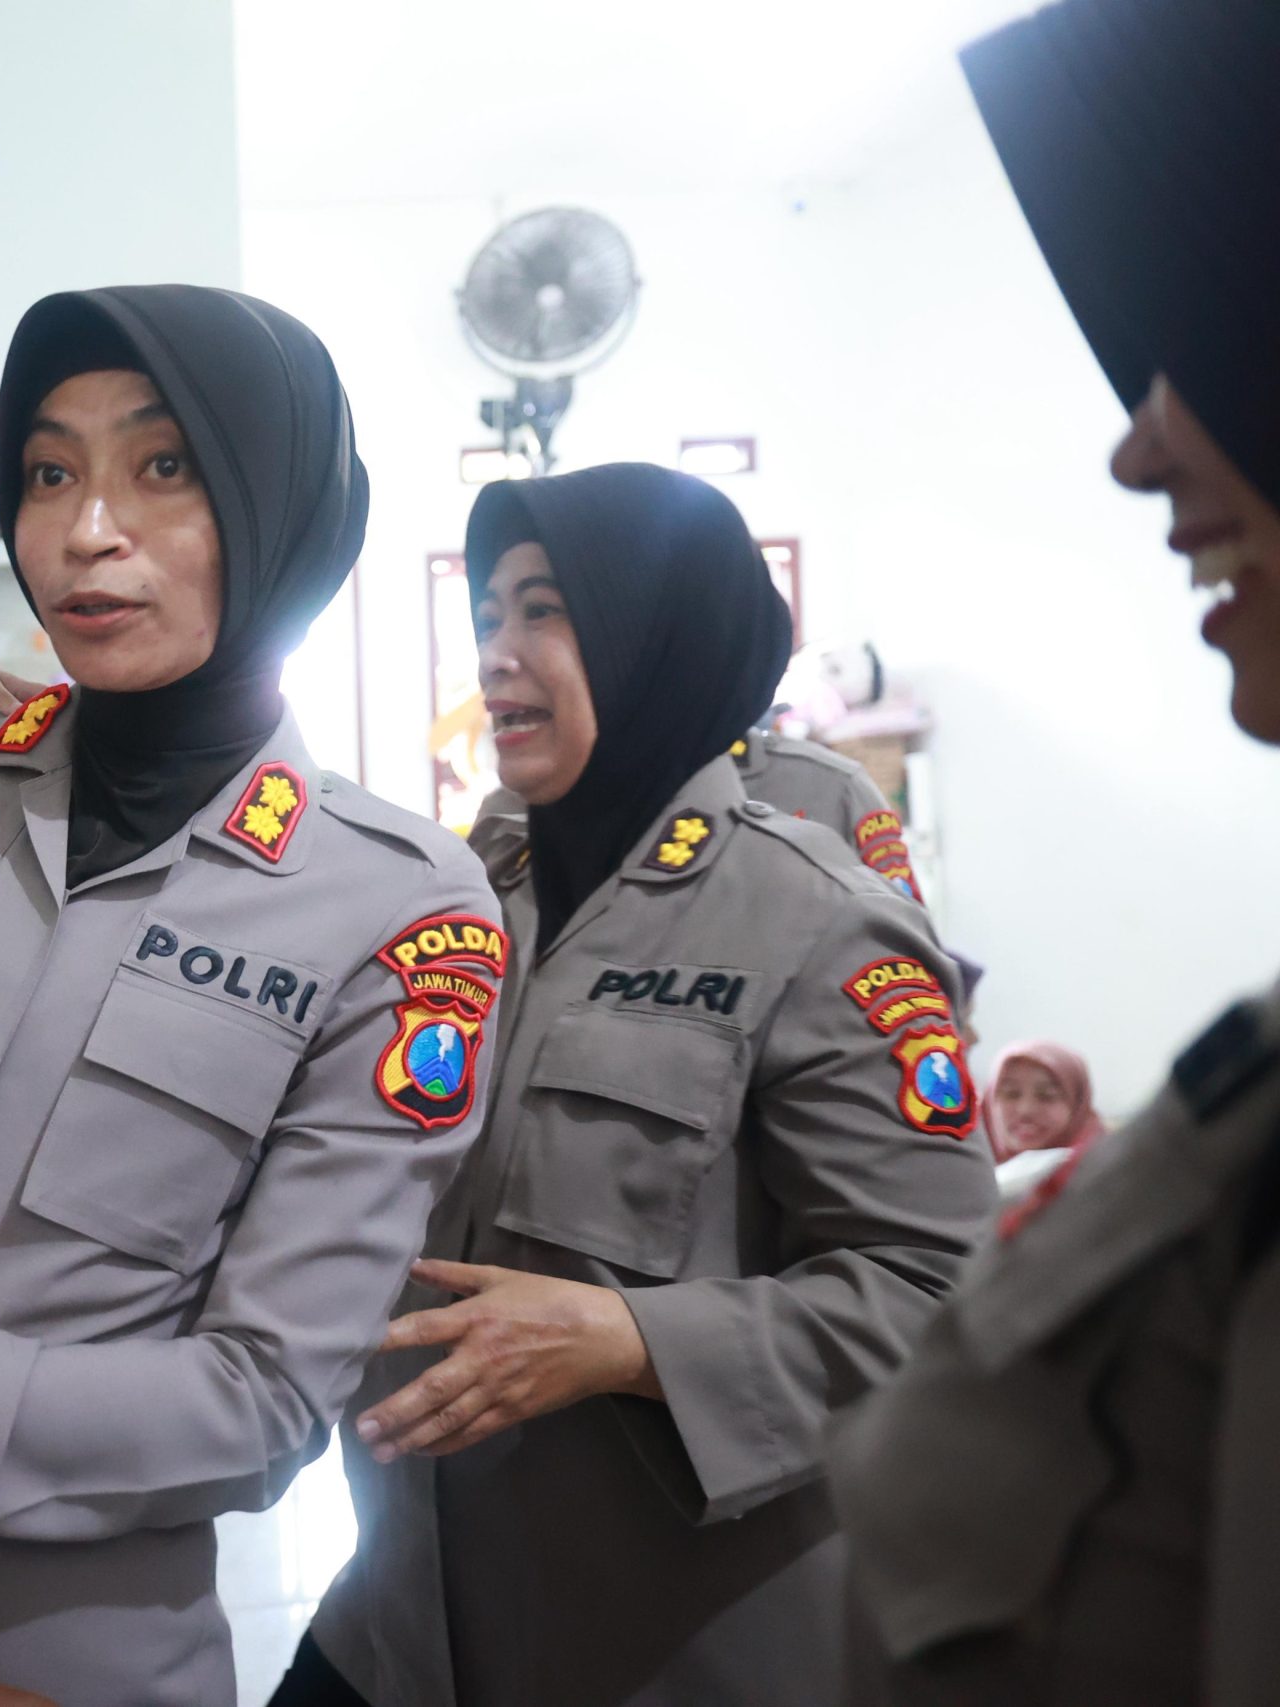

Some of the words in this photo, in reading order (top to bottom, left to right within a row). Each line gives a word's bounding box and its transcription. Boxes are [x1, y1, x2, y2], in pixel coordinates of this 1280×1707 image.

[393, 923, 503, 967] POLDA
[135, 923, 319, 1025] POLRI
[413, 973, 453, 991] JAWA
[454, 978, 489, 1006] TIMUR
[588, 967, 746, 1016] POLRI
[852, 962, 933, 999] POLDA
